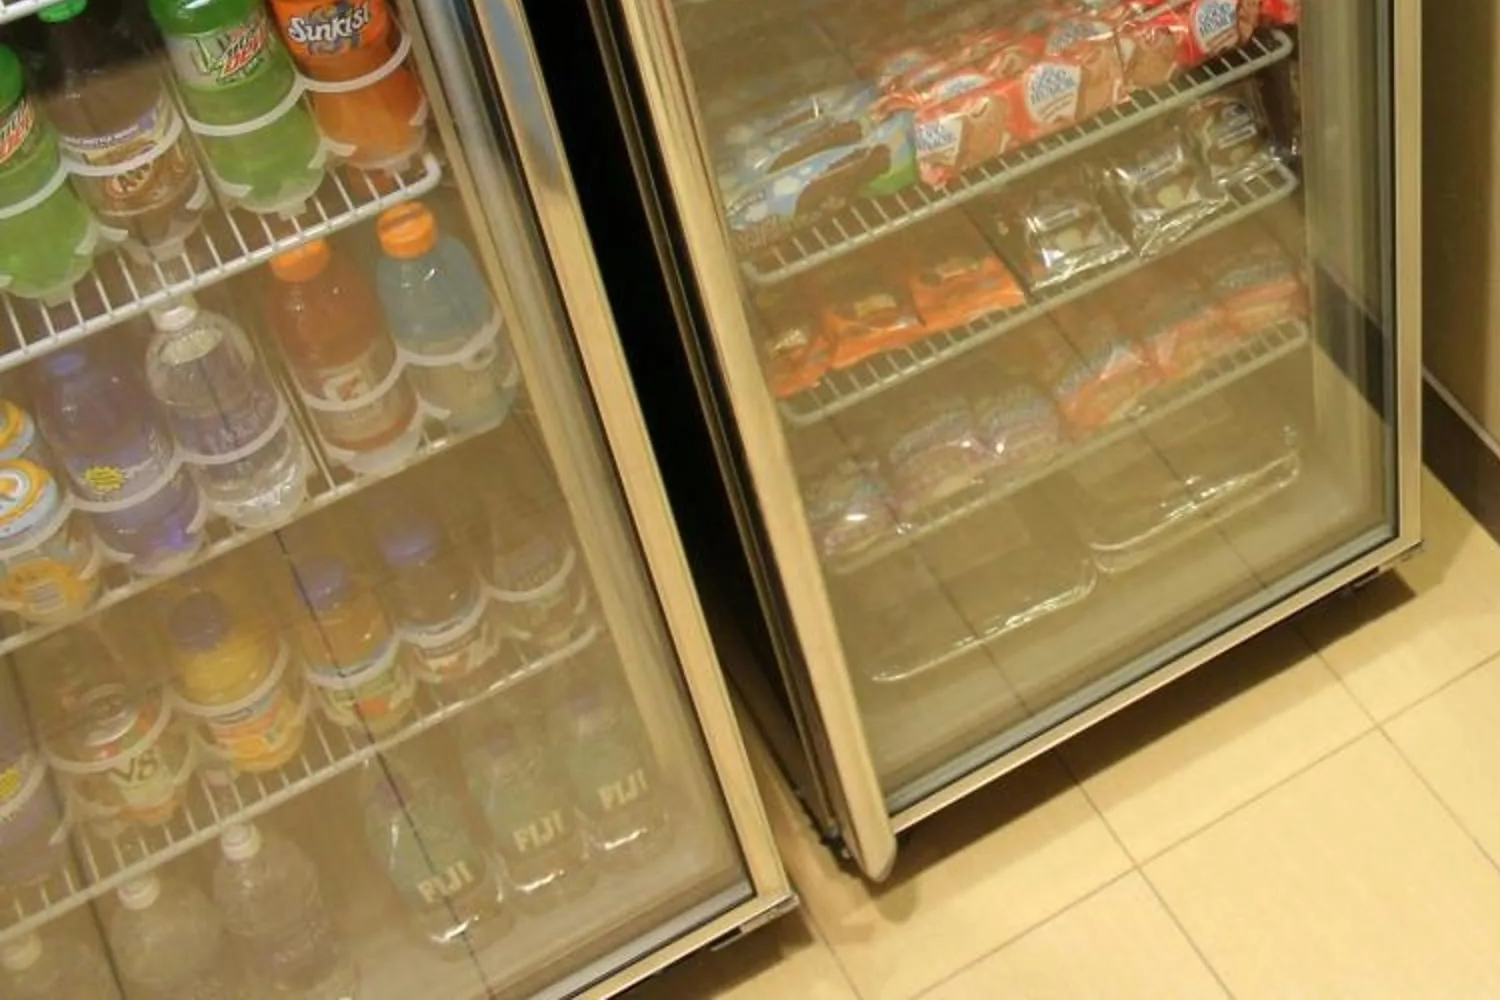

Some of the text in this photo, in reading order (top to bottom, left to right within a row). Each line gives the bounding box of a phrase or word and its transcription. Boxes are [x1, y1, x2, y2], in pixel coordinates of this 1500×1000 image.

[289, 2, 370, 42] Sunkist
[513, 811, 564, 852] FIJI
[417, 861, 474, 903] FIJI
